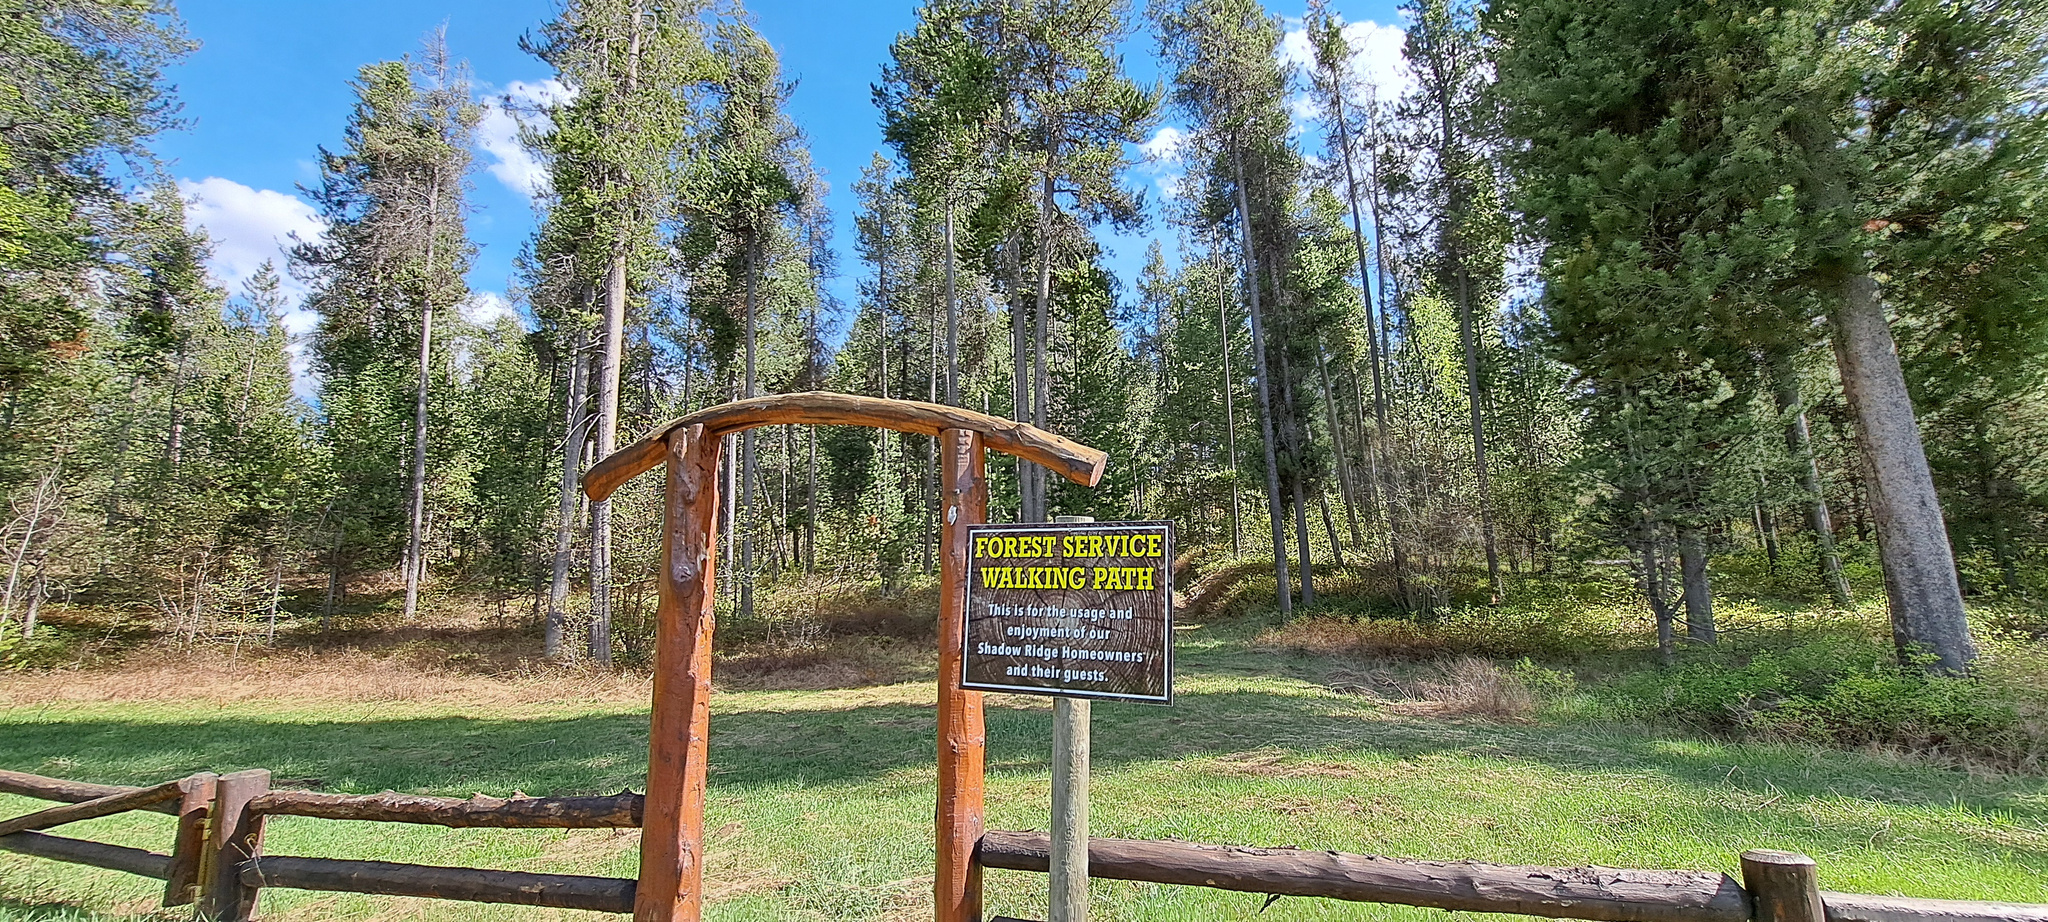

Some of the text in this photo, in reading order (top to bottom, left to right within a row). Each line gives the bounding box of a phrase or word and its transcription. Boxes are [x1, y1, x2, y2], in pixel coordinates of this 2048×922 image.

[975, 534, 1162, 558] FOREST SERVICE
[980, 566, 1155, 590] WALKING PATH
[988, 603, 1133, 621] This is for the usage and
[1007, 624, 1110, 640] enjoyment of our
[977, 641, 1143, 663] Shadow Ridge Homeowners
[1006, 663, 1109, 683] and their guests.
